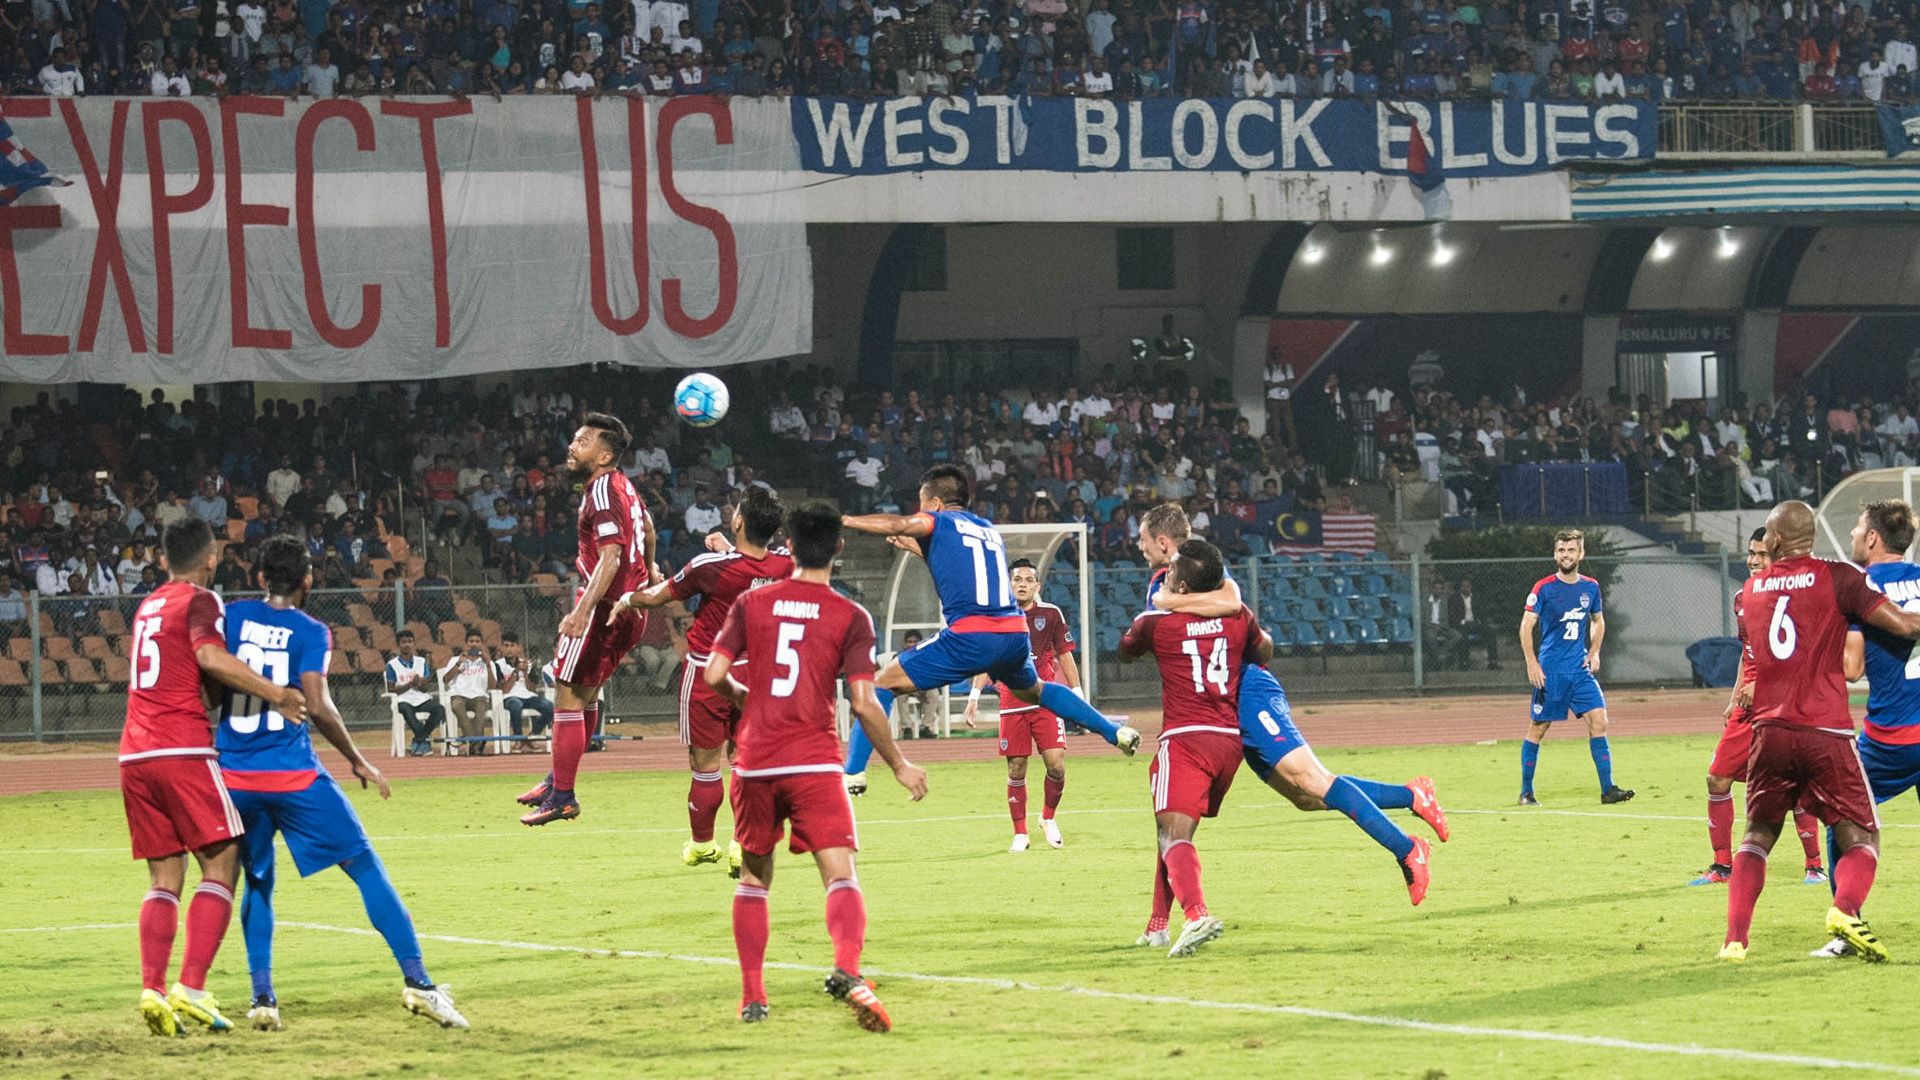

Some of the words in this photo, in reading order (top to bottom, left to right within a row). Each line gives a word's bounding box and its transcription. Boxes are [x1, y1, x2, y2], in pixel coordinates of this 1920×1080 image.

[806, 95, 1013, 168] WEST
[1074, 97, 1333, 170] BLOCK
[1376, 98, 1640, 170] BLUES
[0, 95, 473, 356] EXPECT
[575, 95, 738, 338] US
[1615, 326, 1698, 341] ENGALURU
[1713, 326, 1732, 341] FC
[962, 535, 1011, 607] 11
[1752, 572, 1816, 593] M.ANTONIO
[772, 599, 820, 619] AMIRUL
[1186, 618, 1224, 637] HARISS
[1768, 595, 1797, 660] 6
[130, 616, 163, 690] 15
[771, 622, 805, 697] 5
[1182, 637, 1230, 695] 14
[1257, 710, 1280, 736] 6
